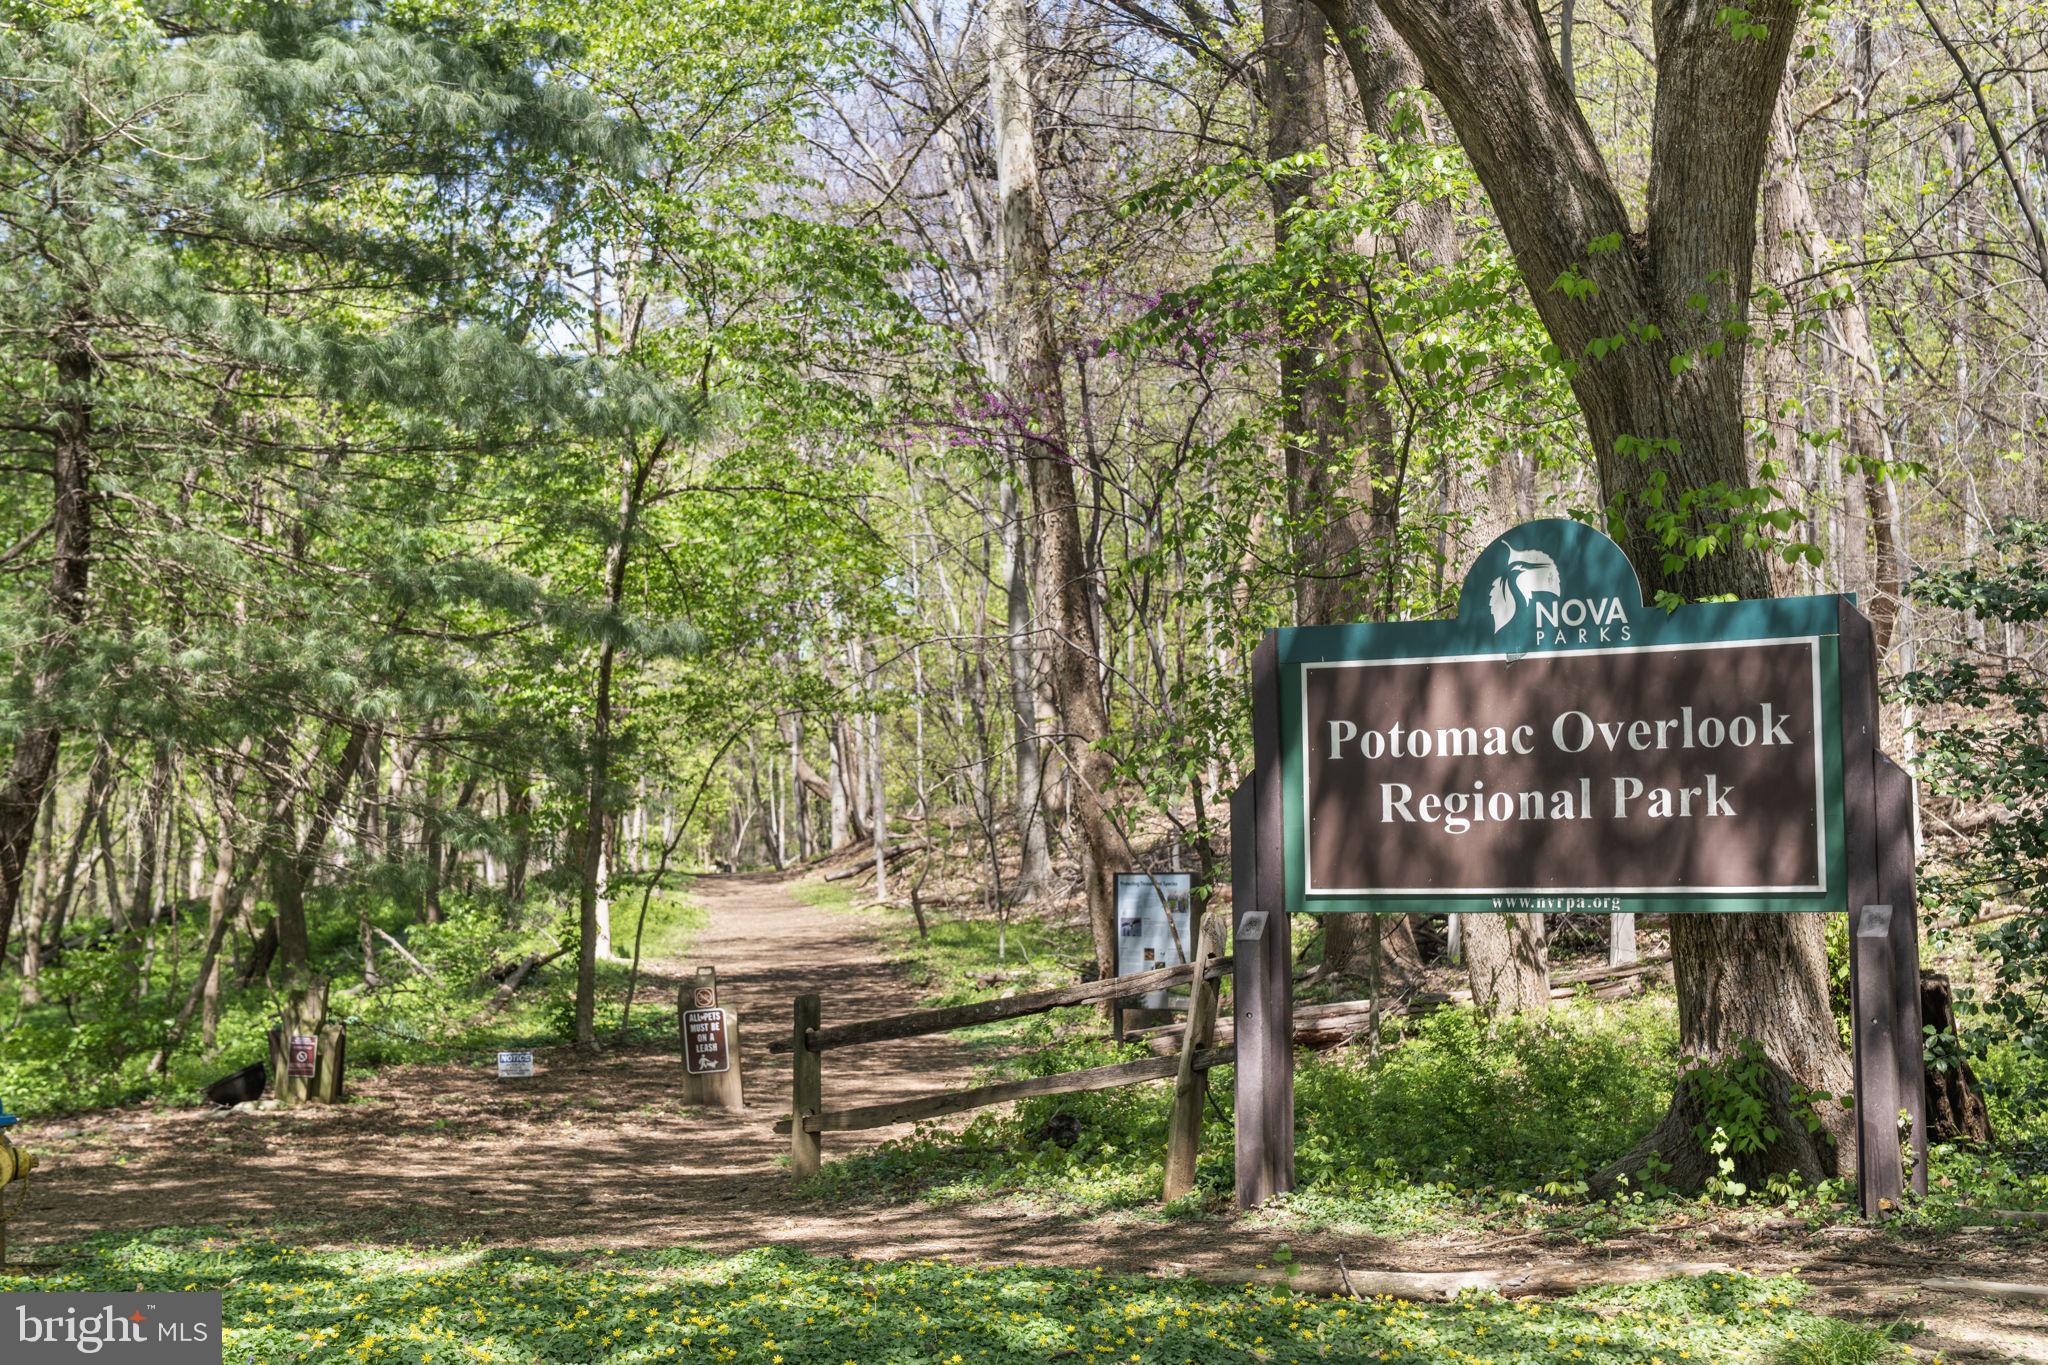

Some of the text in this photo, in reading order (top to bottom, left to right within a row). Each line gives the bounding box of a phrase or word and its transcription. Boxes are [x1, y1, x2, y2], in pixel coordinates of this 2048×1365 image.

[1535, 597, 1628, 628] NOVA
[1536, 625, 1631, 646] PARKS
[1328, 703, 1794, 760] Potomac Overlook
[1379, 774, 1738, 835] Regional Park
[1492, 896, 1621, 912] www.nvrpa.org
[690, 1022, 720, 1032] MUST BE
[697, 1033, 715, 1042] ON A
[696, 1043, 718, 1053] LEASH
[500, 1054, 531, 1062] NOTICE
